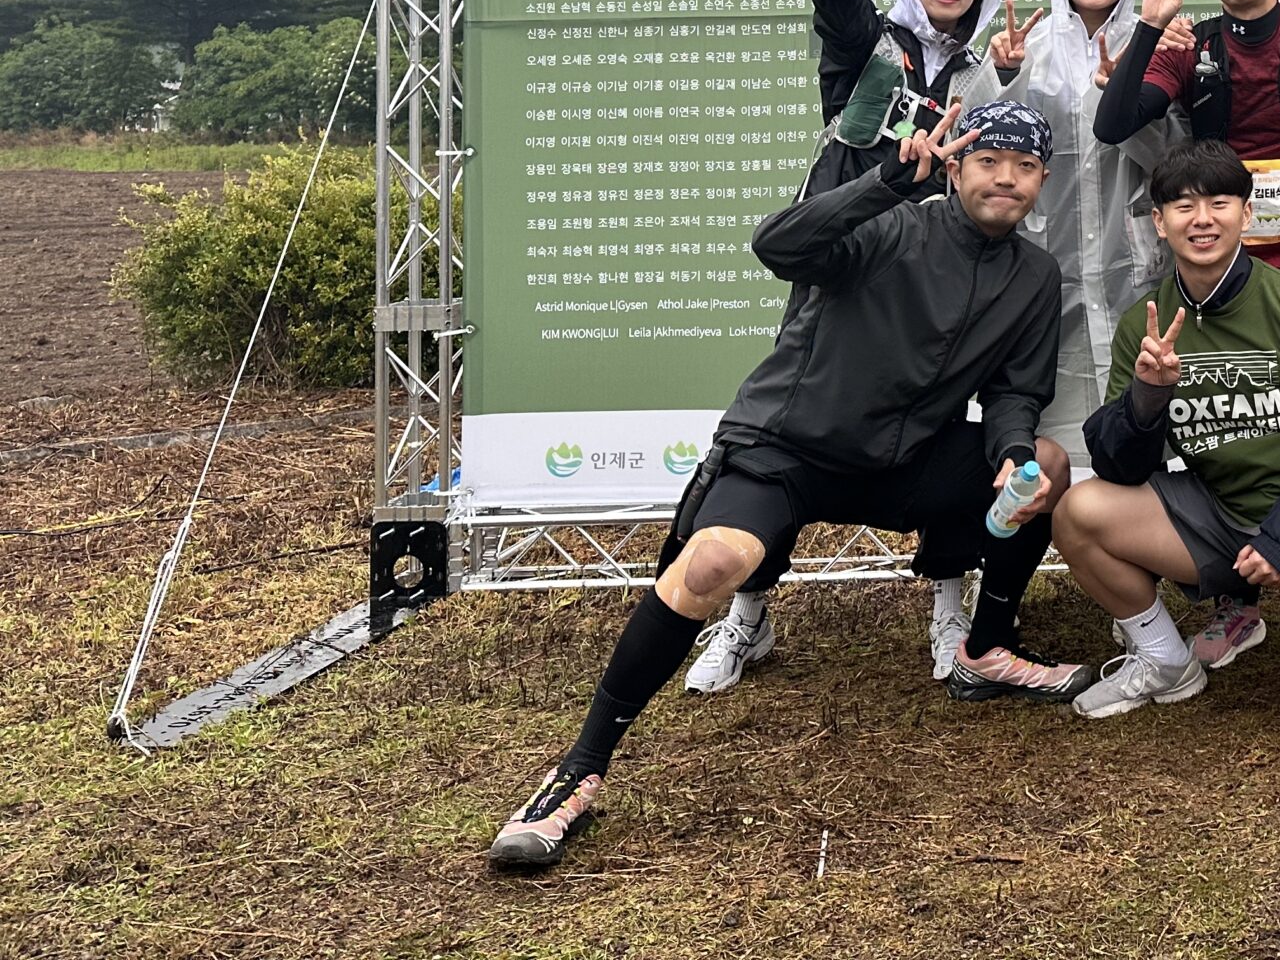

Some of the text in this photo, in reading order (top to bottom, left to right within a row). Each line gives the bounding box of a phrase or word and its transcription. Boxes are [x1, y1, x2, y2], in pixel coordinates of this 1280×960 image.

[526, 3, 555, 13] 소진원
[596, 1, 626, 12] 손동진
[527, 29, 556, 39] 신정수
[598, 27, 628, 37] 신한나
[527, 55, 556, 66] 오세영
[562, 54, 592, 65] 오세준
[527, 82, 556, 94] 이규경
[597, 80, 628, 92] 이기남
[562, 109, 591, 120] 이시영
[526, 136, 555, 148] 이지영
[633, 134, 662, 145] 이진석
[526, 164, 556, 175] 장용민
[633, 161, 663, 173] 장재호
[527, 191, 556, 203] 정우영
[598, 189, 628, 201] 정유진
[527, 218, 556, 230] 조용임
[634, 216, 665, 227] 조은아
[527, 246, 557, 257] 최숙자
[598, 244, 628, 256] 최영석
[563, 273, 592, 284] 한창수
[535, 300, 563, 312] Astrid
[565, 300, 608, 313] Monique
[657, 298, 684, 310] Athol
[685, 298, 709, 310] Jake
[759, 296, 785, 310] Carly
[541, 329, 560, 340] KIM
[628, 326, 651, 338] Leila
[729, 326, 747, 338] Lok
[748, 324, 776, 338] Hong
[591, 452, 645, 470] 인제군
